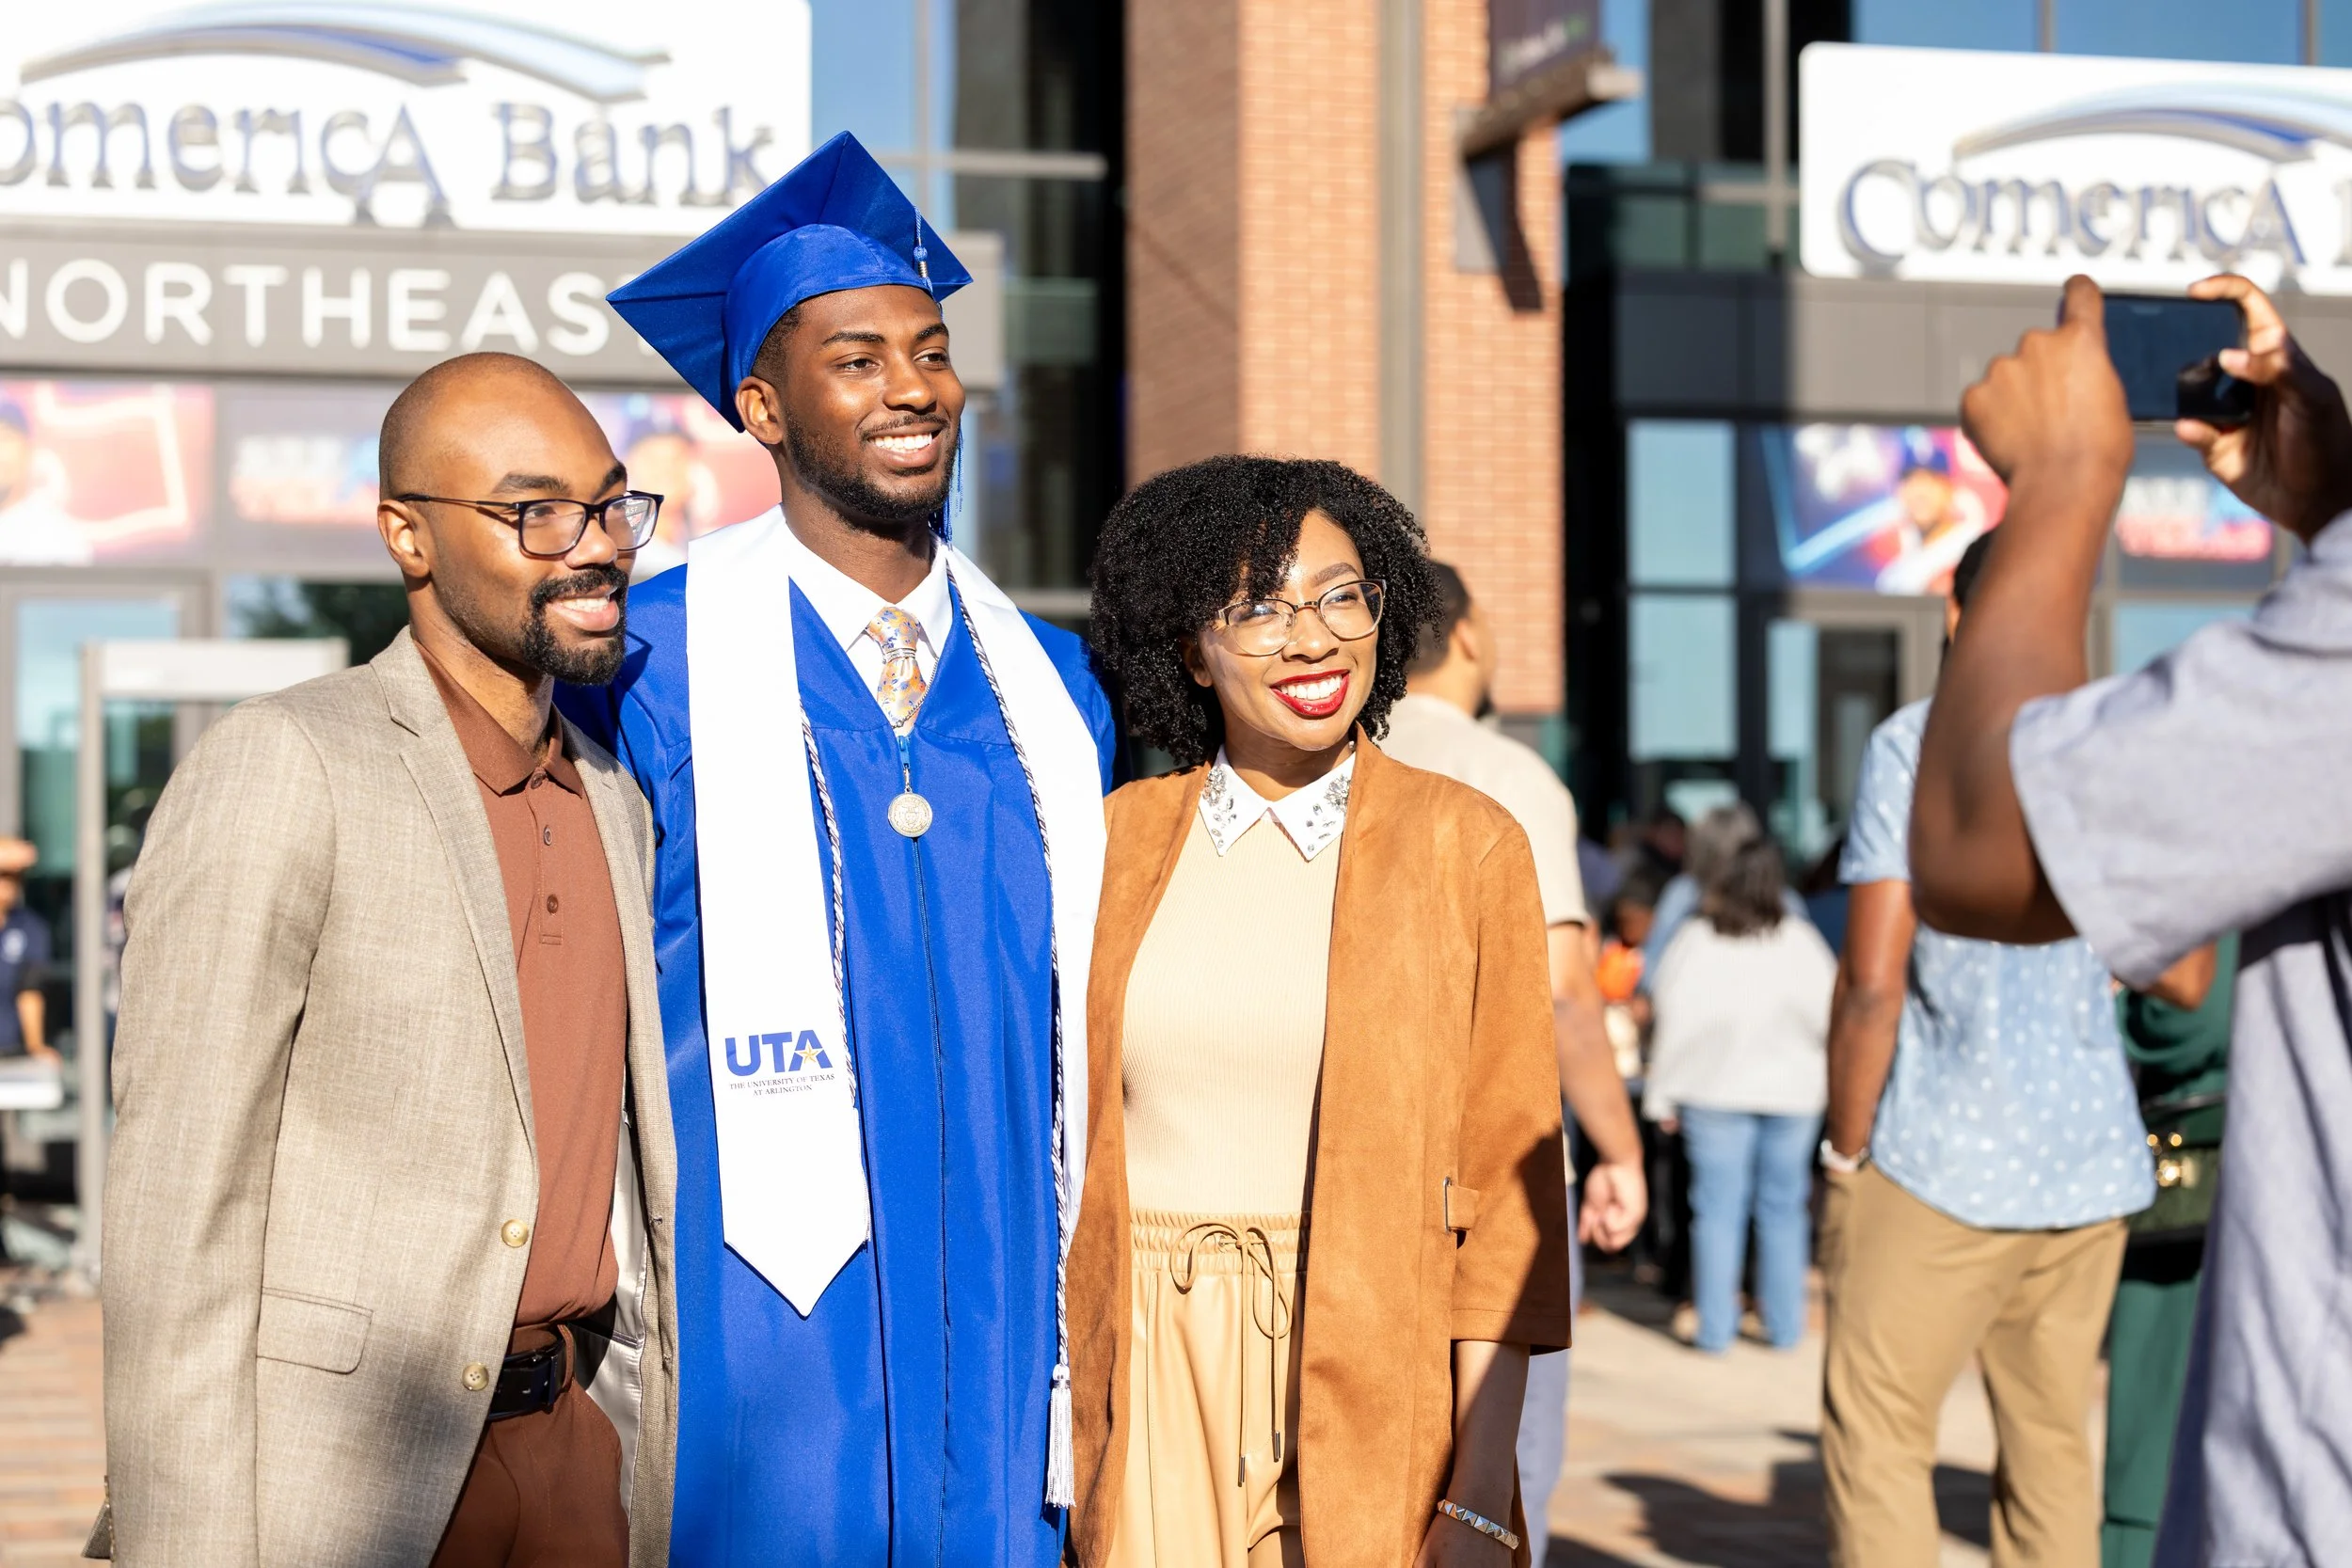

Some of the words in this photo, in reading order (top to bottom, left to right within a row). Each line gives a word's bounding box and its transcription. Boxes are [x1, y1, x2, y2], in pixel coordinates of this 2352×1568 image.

[491, 102, 773, 207] Bank
[725, 1030, 833, 1076] UTA
[729, 1082, 746, 1090] THE
[747, 1077, 795, 1088] UNIVERSITY
[810, 1073, 835, 1082] TEXAS
[753, 1088, 763, 1097] AT
[765, 1084, 813, 1095] ARLINGTON
